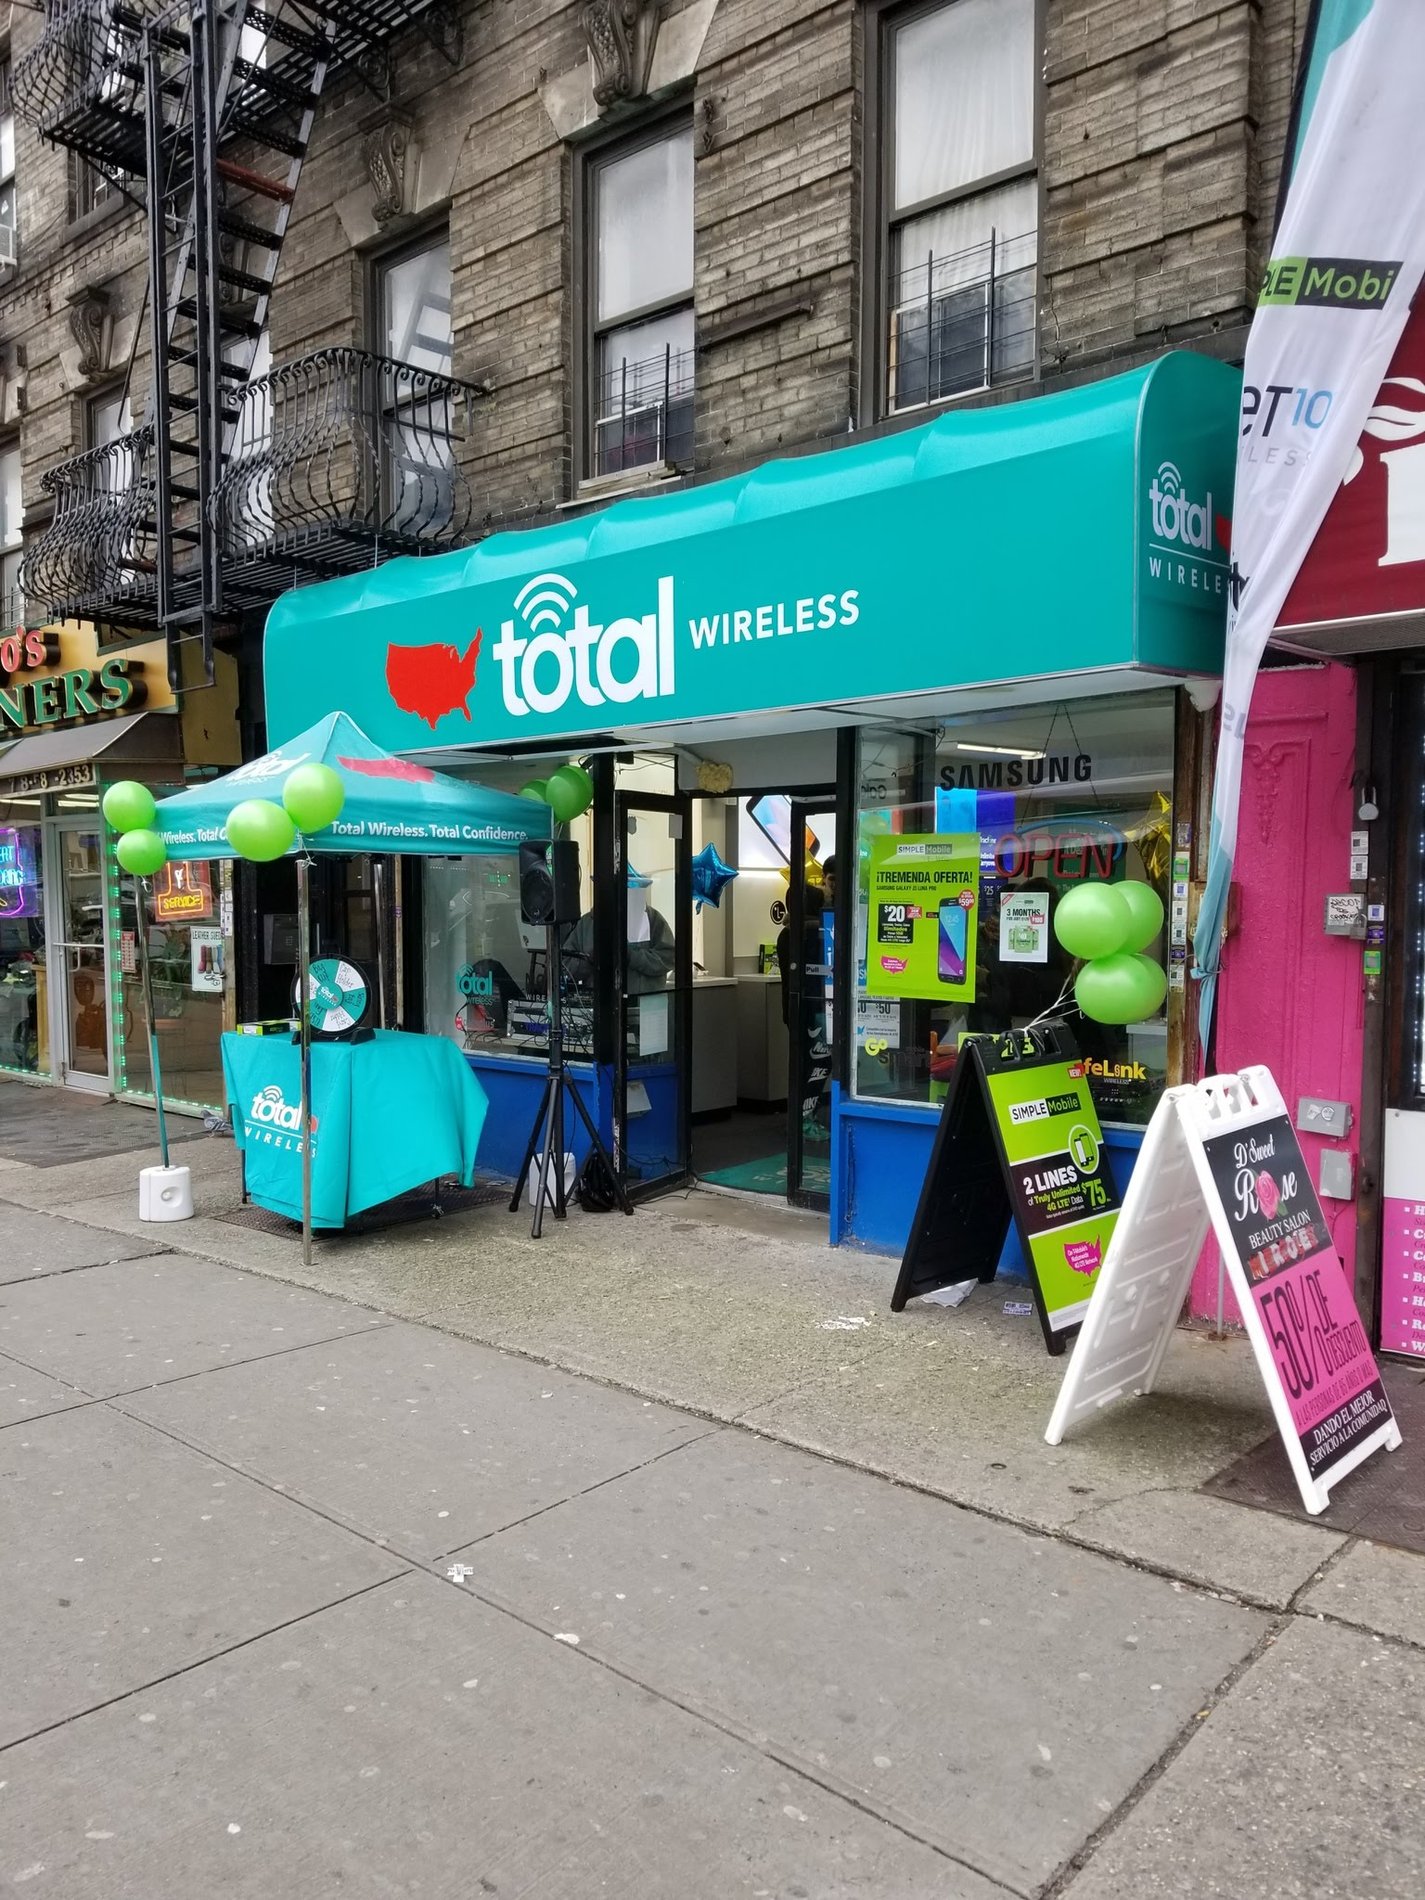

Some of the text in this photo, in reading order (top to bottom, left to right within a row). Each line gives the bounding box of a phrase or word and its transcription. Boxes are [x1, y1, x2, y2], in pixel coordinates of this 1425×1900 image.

[1304, 267, 1394, 301] Mobi
[1242, 385, 1335, 437] eT10
[1149, 477, 1212, 551] total
[1149, 556, 1221, 594] WIRELE
[492, 575, 861, 716] total WIRELESS
[940, 754, 1092, 791] SAMSUNG
[197, 827, 218, 842] Total
[331, 821, 529, 841] Total Wireless. Total Confidence.
[898, 845, 951, 854] SIMPLE Mobile
[995, 833, 1115, 878] OPEN
[876, 871, 973, 884] ¡TREMENDA OFERTA!
[884, 904, 906, 922] $20
[1006, 908, 1041, 917] 3 MONTHS
[456, 970, 493, 996] total
[875, 1002, 891, 1015] $50
[251, 1091, 303, 1132] total
[1012, 1096, 1079, 1120] SIMPLE Mobile
[244, 1127, 317, 1159] WIRELES
[1023, 1165, 1078, 1196] 2 LINES
[1034, 1193, 1051, 1205] Truly
[1051, 1184, 1081, 1200] Unlimited
[1081, 1178, 1108, 1208] $75
[1046, 1201, 1056, 1212] 4G
[1071, 1195, 1084, 1205] Data
[1248, 1209, 1312, 1250] BEAUTY SALON
[1260, 1275, 1334, 1400] 50%
[1306, 1269, 1338, 1336] DE
[1326, 1320, 1368, 1371] DESCUENTO
[1313, 1389, 1376, 1446] DANDO EL MEJOR
[1309, 1434, 1340, 1466] SERVICIO
[1344, 1425, 1355, 1441] LA
